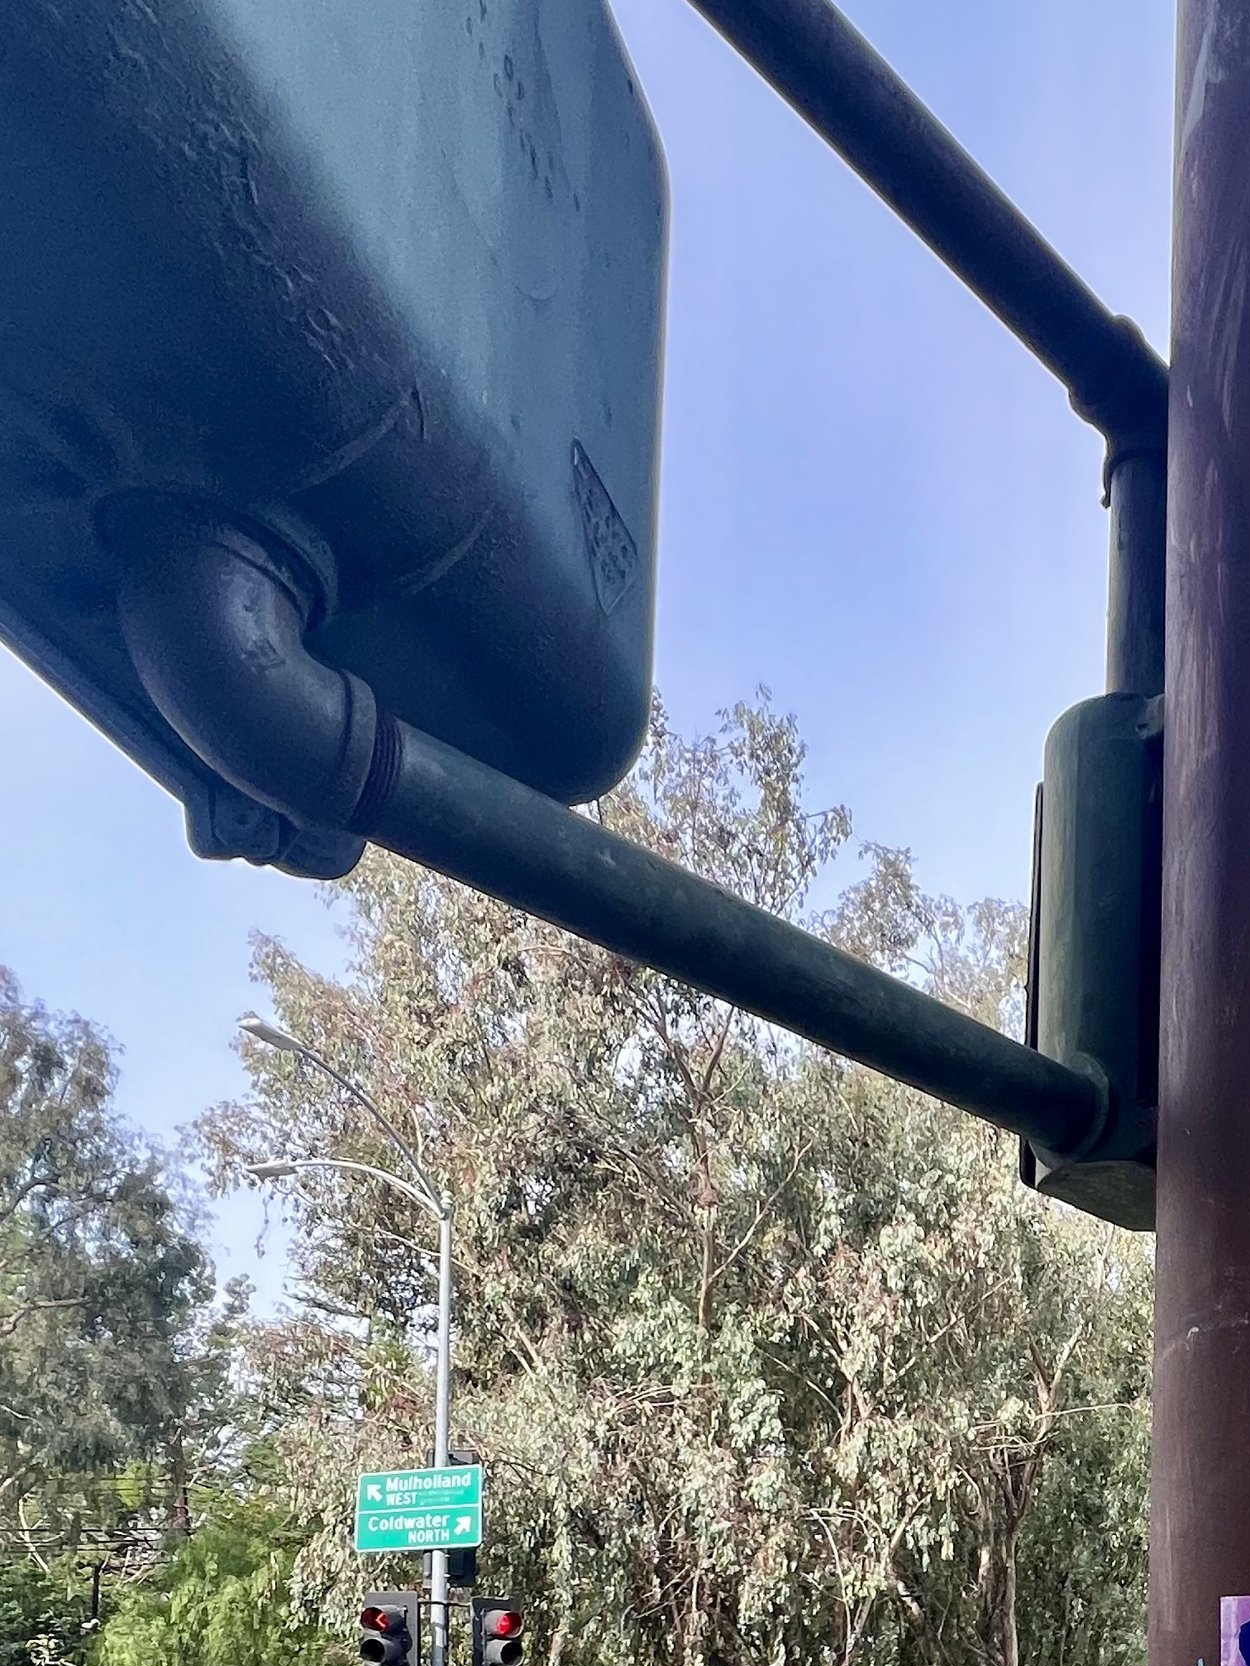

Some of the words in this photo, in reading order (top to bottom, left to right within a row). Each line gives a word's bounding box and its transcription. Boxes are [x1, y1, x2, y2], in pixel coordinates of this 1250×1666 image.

[386, 1472, 472, 1492] Mulholland
[386, 1492, 418, 1506] WEST
[368, 1513, 450, 1532] Coldwater
[408, 1528, 450, 1543] NORTH
